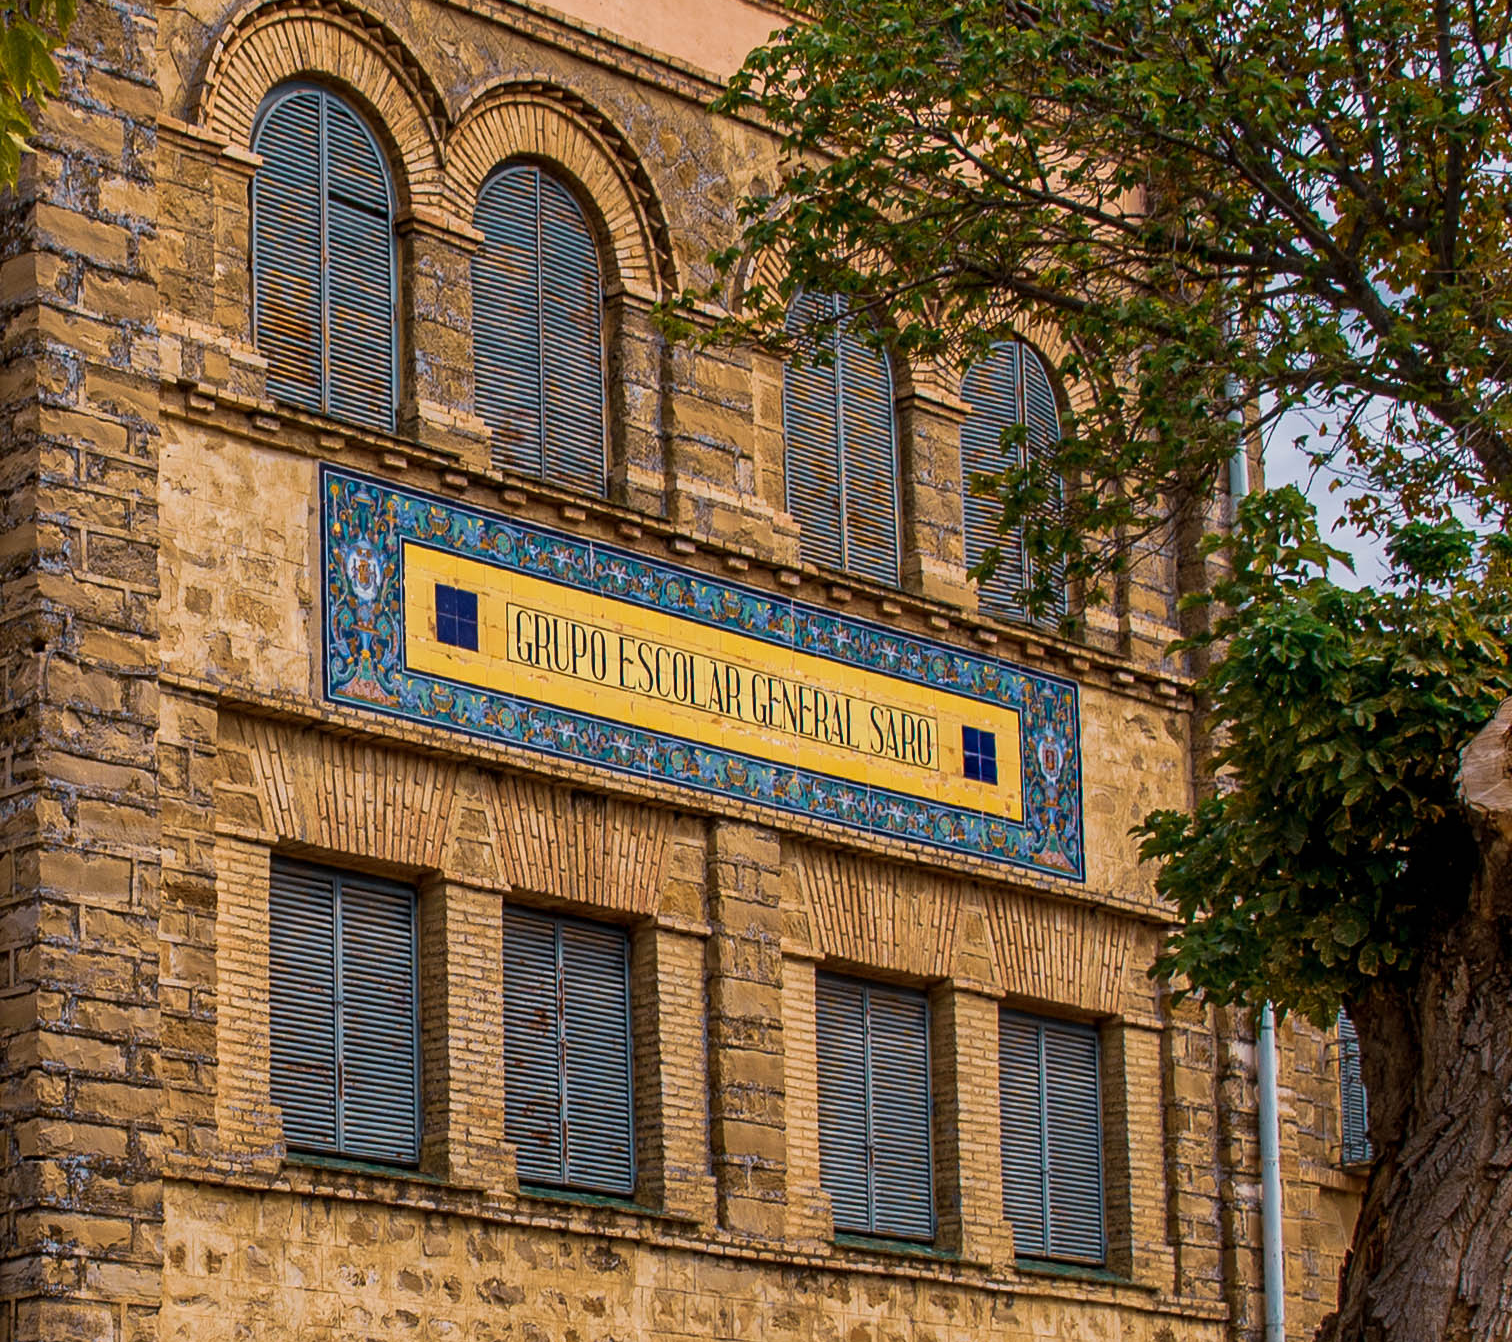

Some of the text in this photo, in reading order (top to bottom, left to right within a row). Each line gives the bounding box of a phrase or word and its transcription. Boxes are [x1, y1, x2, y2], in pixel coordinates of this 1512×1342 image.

[516, 610, 932, 766] GRUPO ESCOLAR GENERAL SARO
